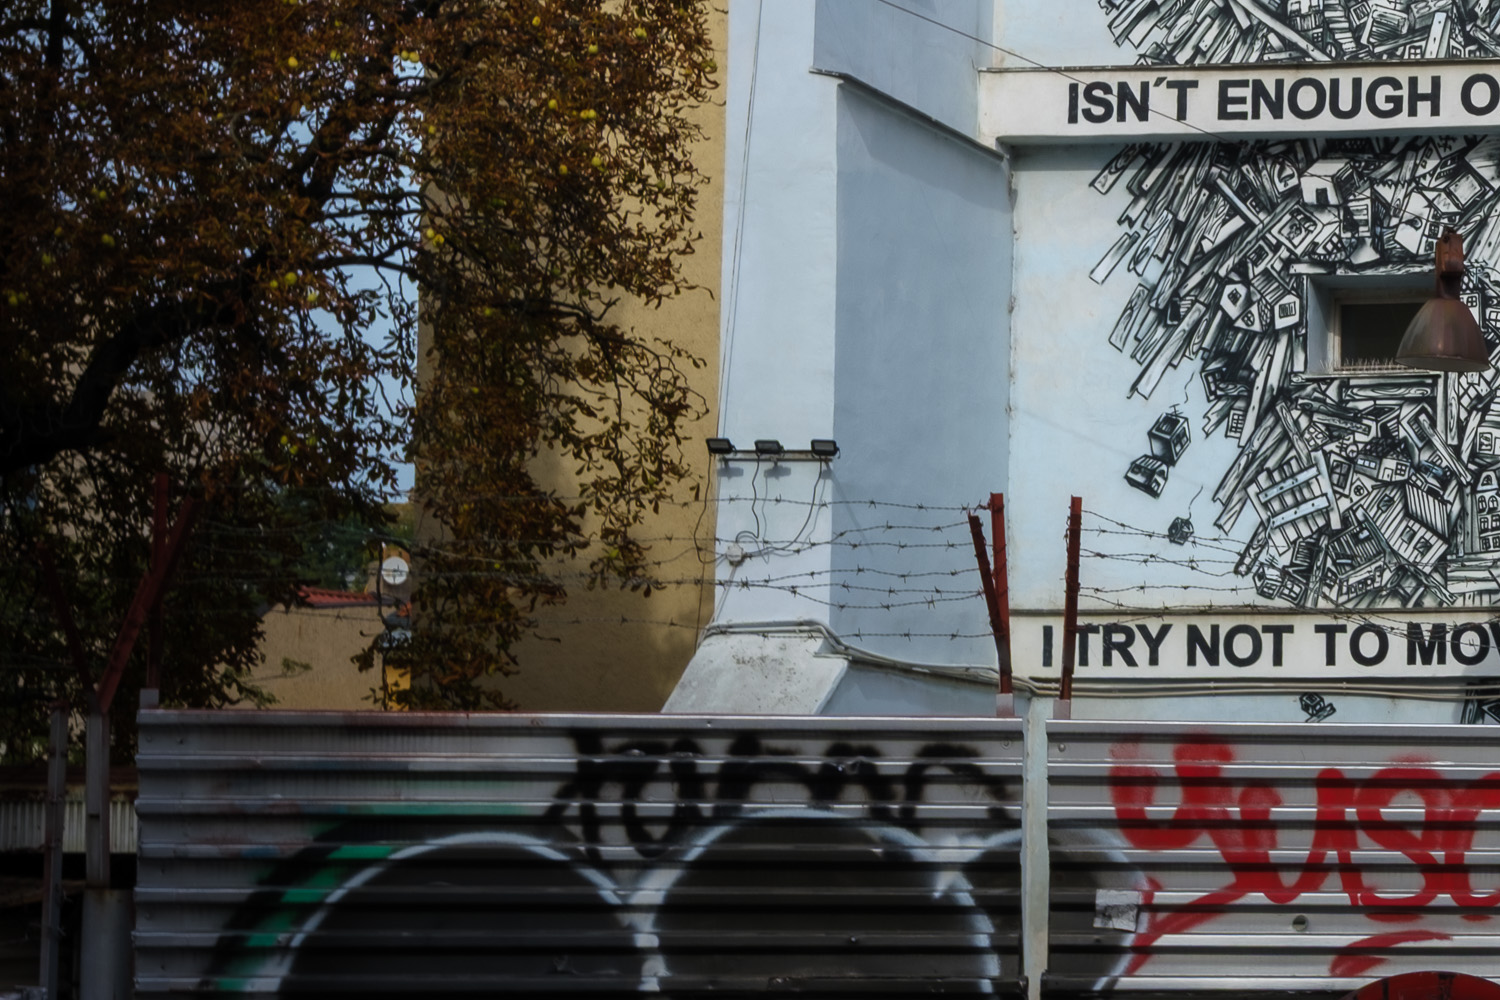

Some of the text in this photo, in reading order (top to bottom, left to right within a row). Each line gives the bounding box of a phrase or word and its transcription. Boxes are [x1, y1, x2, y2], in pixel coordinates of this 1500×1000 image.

[1066, 75, 1200, 124] ISN'T
[1216, 75, 1442, 121] ENOUGH
[1042, 624, 1054, 667] I
[1076, 623, 1173, 667] TRY
[1186, 623, 1294, 667] NOT
[1314, 622, 1389, 667] TO
